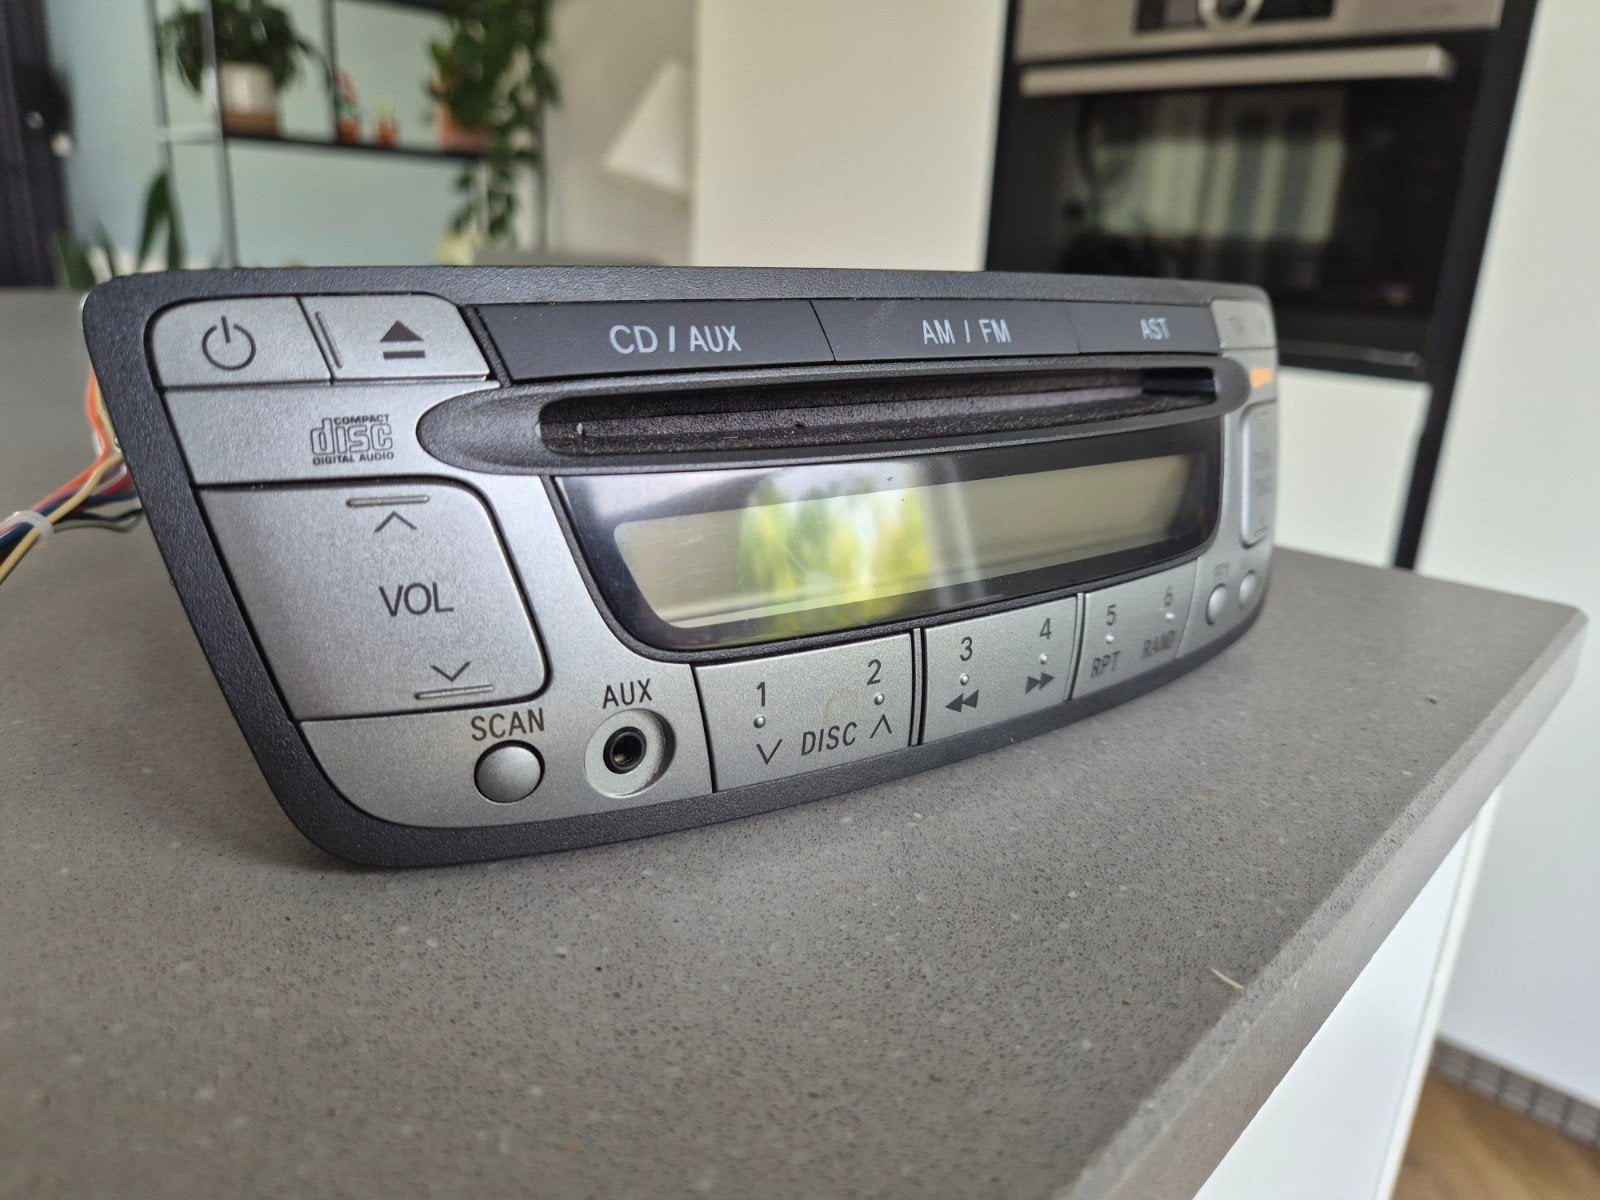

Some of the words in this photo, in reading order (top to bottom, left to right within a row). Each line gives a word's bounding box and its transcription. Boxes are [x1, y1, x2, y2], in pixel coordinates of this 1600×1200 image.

[609, 325, 658, 354] CD
[689, 325, 742, 353] AUX
[922, 319, 956, 345] AM
[978, 318, 1012, 344] FM
[1140, 317, 1170, 340] AST
[333, 414, 389, 424] COMPACT
[310, 417, 393, 455] disc
[313, 455, 355, 465] DIGITAL
[359, 451, 394, 462] AUDIO
[378, 581, 454, 617] VOL
[1164, 585, 1173, 606] 6
[1106, 604, 1116, 626] 5
[1039, 618, 1052, 640] 4
[959, 636, 973, 662] 3
[867, 658, 882, 685] 2
[1091, 650, 1121, 679] RPT
[602, 678, 653, 709] AUX
[756, 681, 766, 707] 1
[470, 707, 545, 741] SCAN
[801, 721, 858, 756] DISC
